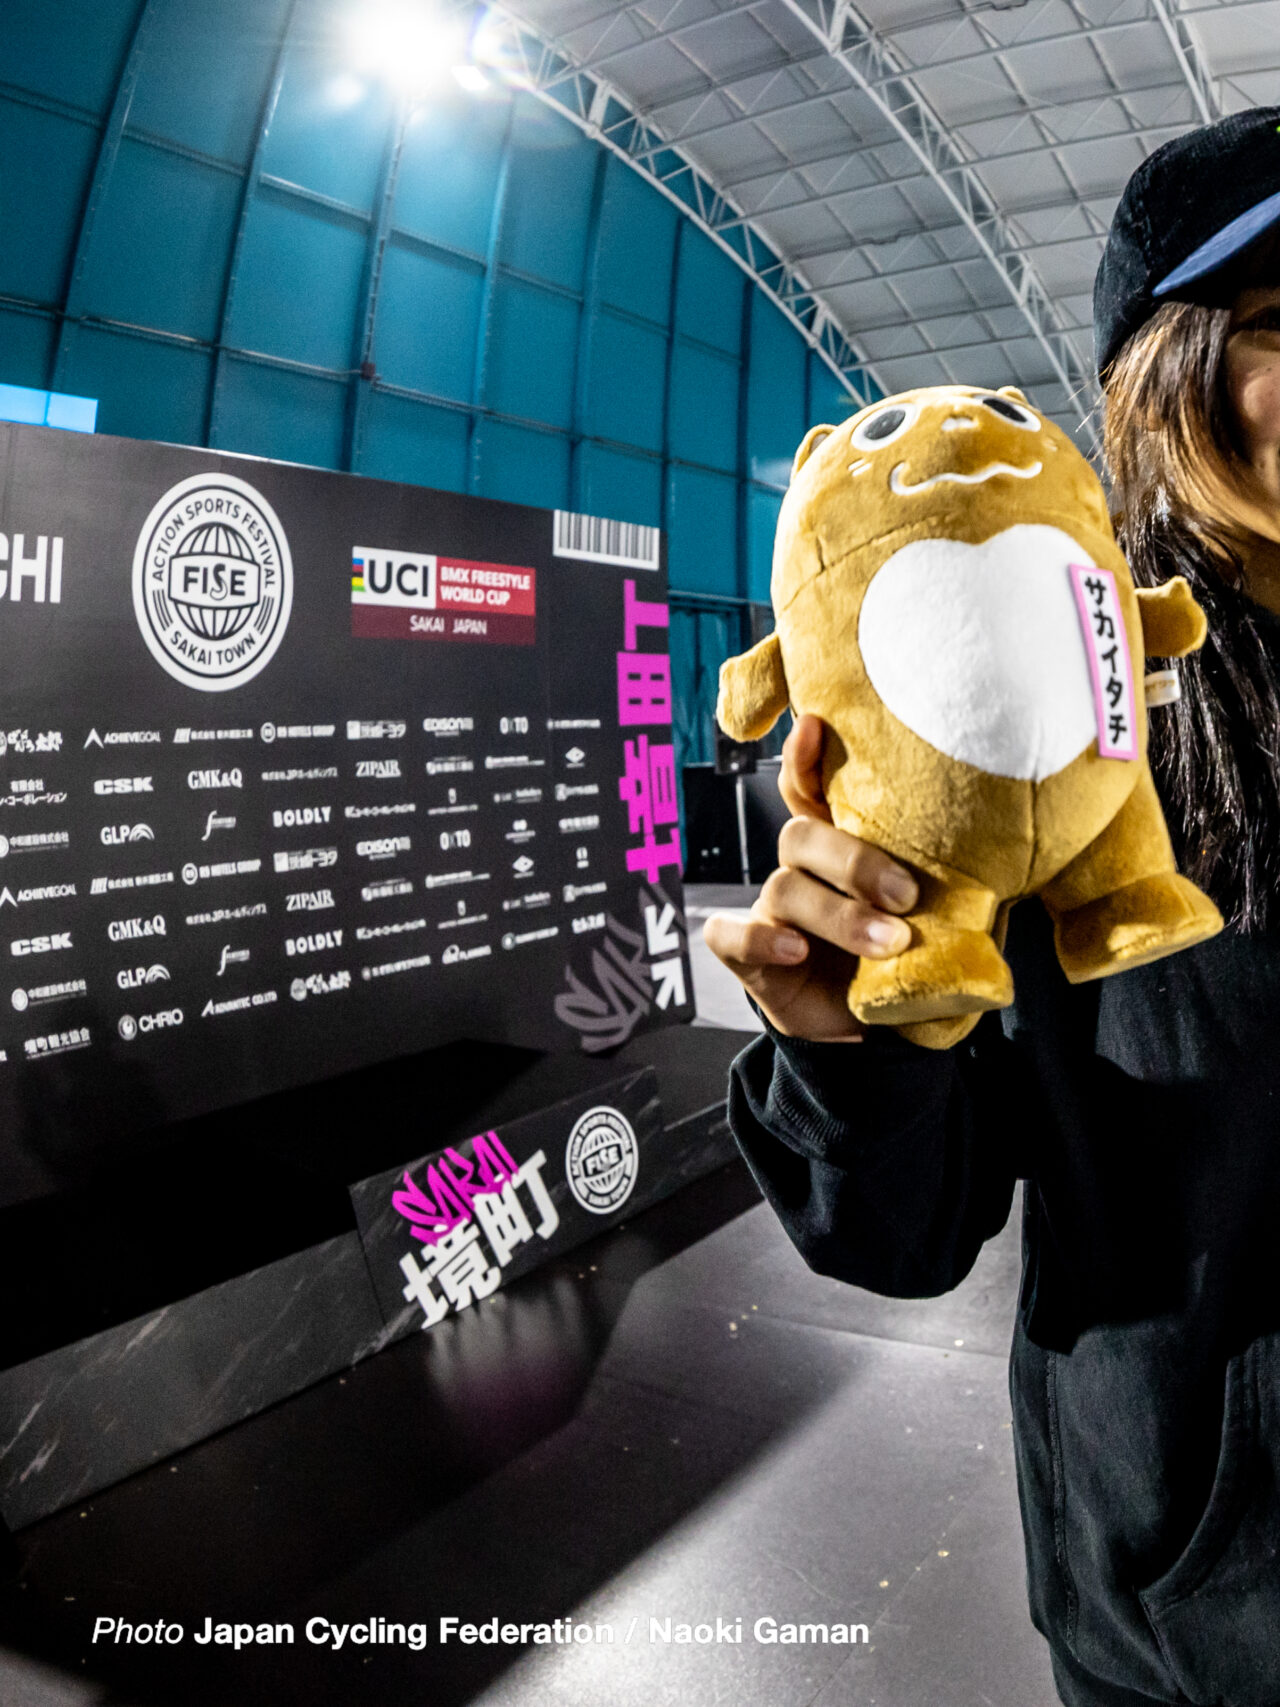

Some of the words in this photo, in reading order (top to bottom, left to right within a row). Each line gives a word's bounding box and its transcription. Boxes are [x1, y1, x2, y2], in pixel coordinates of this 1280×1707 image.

[152, 515, 185, 582] ACTION
[185, 498, 241, 521] SPORTS
[241, 512, 276, 589] FESTIVAL
[0, 532, 64, 604] HI
[368, 559, 429, 597] UCI
[440, 566, 469, 583] BMX
[471, 569, 531, 590] FREESTYLE
[183, 563, 247, 601] FISE
[440, 585, 485, 604] WORLD
[486, 590, 511, 606] CUP
[409, 614, 445, 633] SAKAI
[452, 618, 488, 635] JAPAN
[170, 630, 212, 665] SAKAI
[216, 632, 257, 665] TOWN
[1084, 576, 1127, 744] サカイタチ
[187, 768, 243, 789] GMK&Q
[356, 759, 402, 778] ZIPAIR
[93, 776, 154, 795] CSK
[273, 806, 332, 828] BOLDLY
[100, 825, 130, 846] GLP
[285, 889, 336, 911] ZIPAIR
[107, 914, 167, 942] GMK&Q
[10, 932, 74, 956] CSK
[285, 930, 344, 956] BOLDLY
[117, 967, 146, 989] GLP
[585, 1146, 619, 1176] FISE
[399, 1149, 560, 1330] 境町
